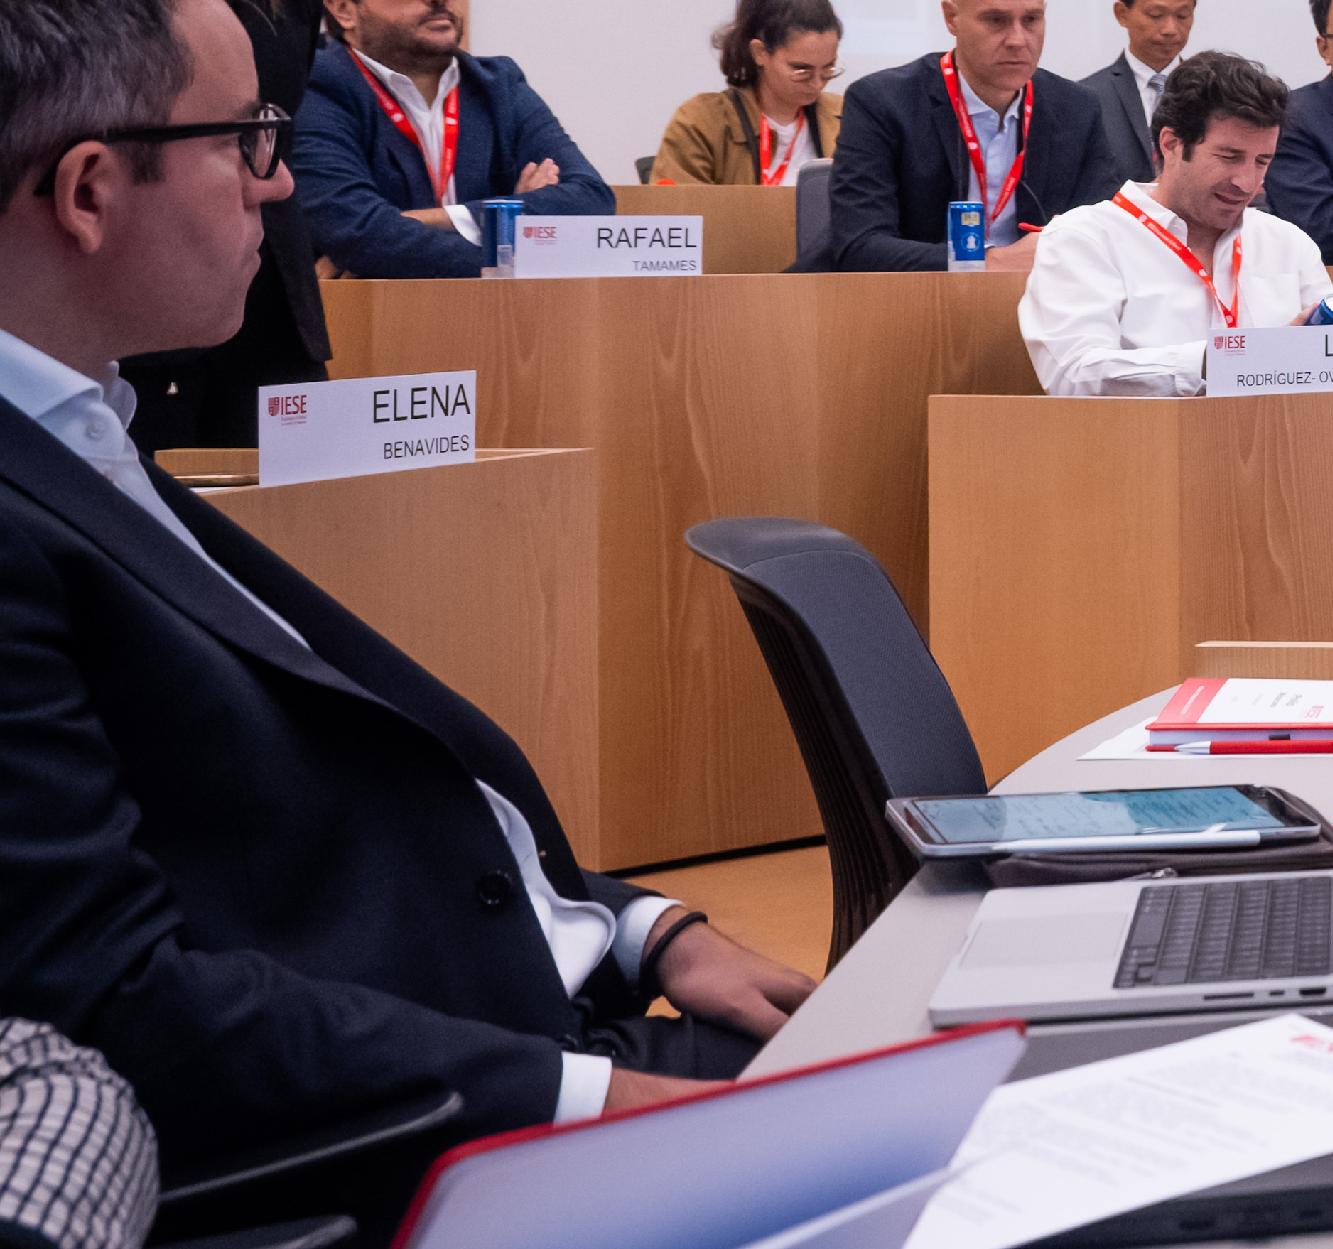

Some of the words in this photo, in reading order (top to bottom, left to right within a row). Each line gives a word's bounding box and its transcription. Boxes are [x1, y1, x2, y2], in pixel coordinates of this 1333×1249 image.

[534, 227, 557, 239] IESE
[597, 228, 697, 249] RAFAEL
[632, 260, 697, 271] TAMAMES
[1224, 336, 1246, 349] IESE
[281, 395, 307, 415] IESE
[373, 384, 471, 424] ELENA
[384, 435, 469, 460] BENAVIDES
